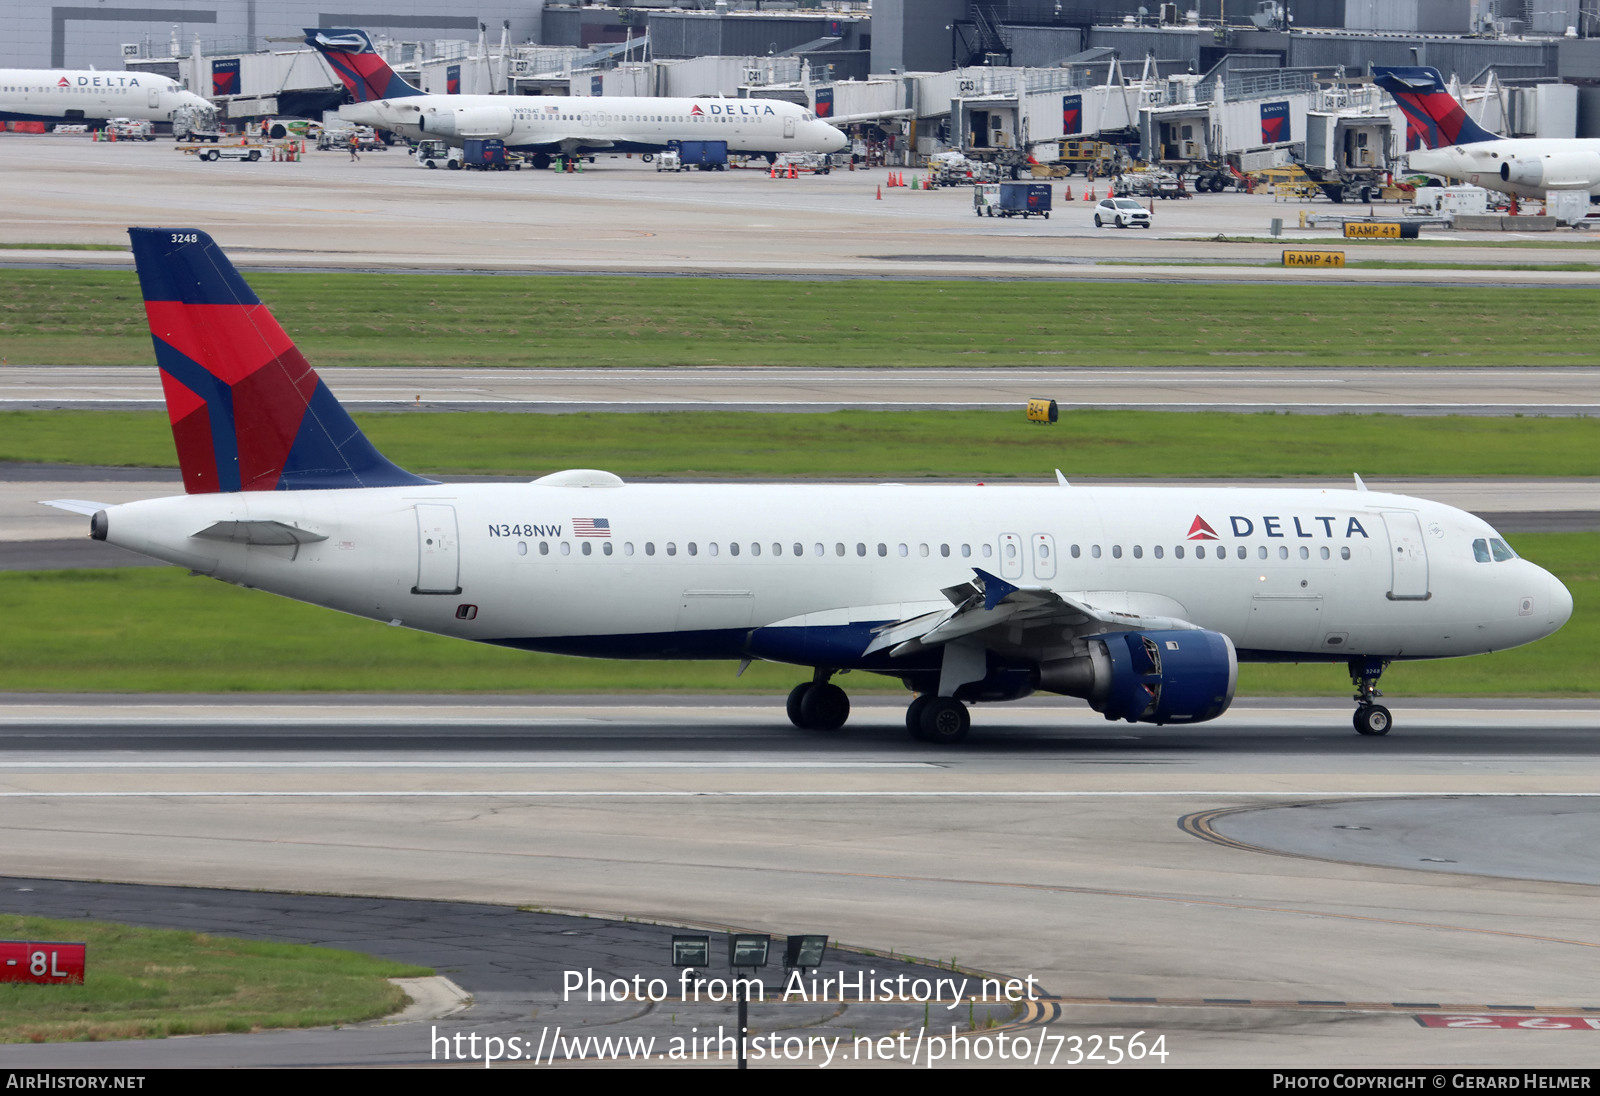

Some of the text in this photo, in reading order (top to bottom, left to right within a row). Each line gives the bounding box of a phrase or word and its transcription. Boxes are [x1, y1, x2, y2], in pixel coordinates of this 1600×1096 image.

[124, 46, 138, 55] C33
[516, 62, 528, 72] C37
[78, 76, 140, 87] DELTA
[748, 71, 761, 82] C41
[959, 80, 974, 91] C43
[1150, 92, 1162, 102] C47
[710, 104, 775, 116] DELTA
[1350, 226, 1389, 236] RAMP 4
[171, 234, 198, 243] 3248
[1288, 254, 1332, 264] RAMP 4
[488, 524, 562, 538] N348NW
[1229, 516, 1370, 538] DELTA
[30, 950, 68, 977] 8L
